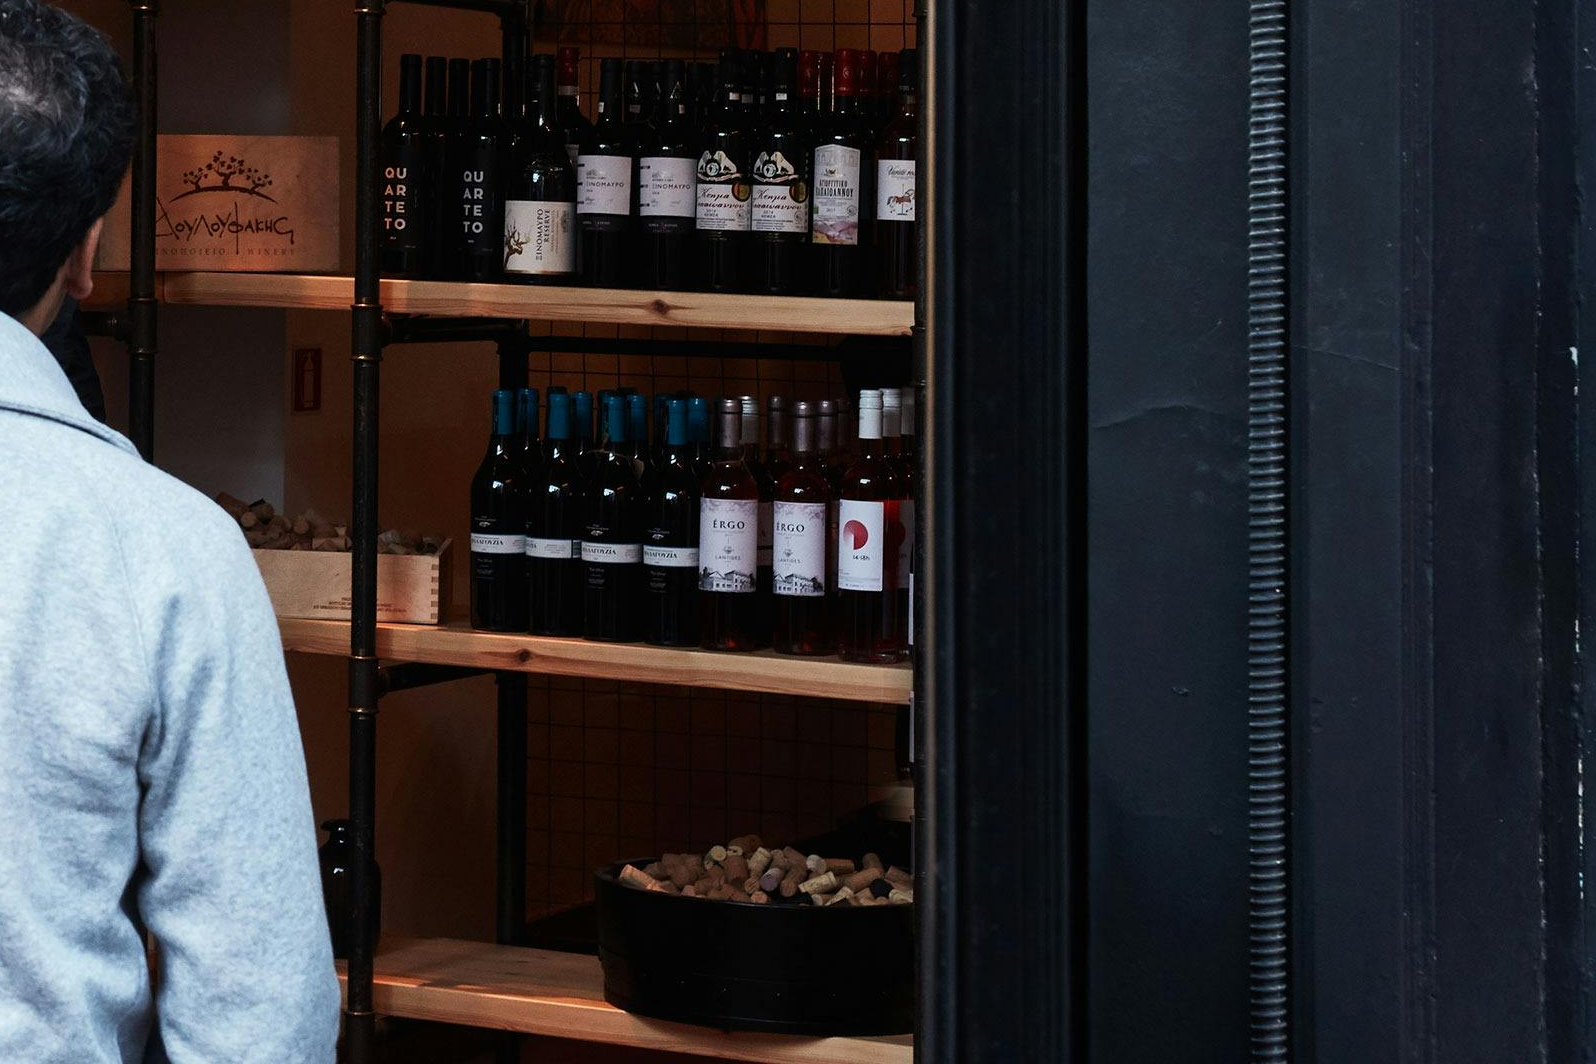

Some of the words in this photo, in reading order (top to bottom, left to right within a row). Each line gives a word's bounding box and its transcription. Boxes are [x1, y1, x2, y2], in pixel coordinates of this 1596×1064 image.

[385, 167, 407, 179] QU
[463, 170, 484, 182] QU
[385, 184, 407, 196] AR
[463, 188, 484, 200] AR
[384, 201, 405, 213] TE
[463, 205, 483, 216] TE
[384, 218, 406, 230] TO
[463, 221, 483, 234] TO
[247, 247, 294, 256] WINERY
